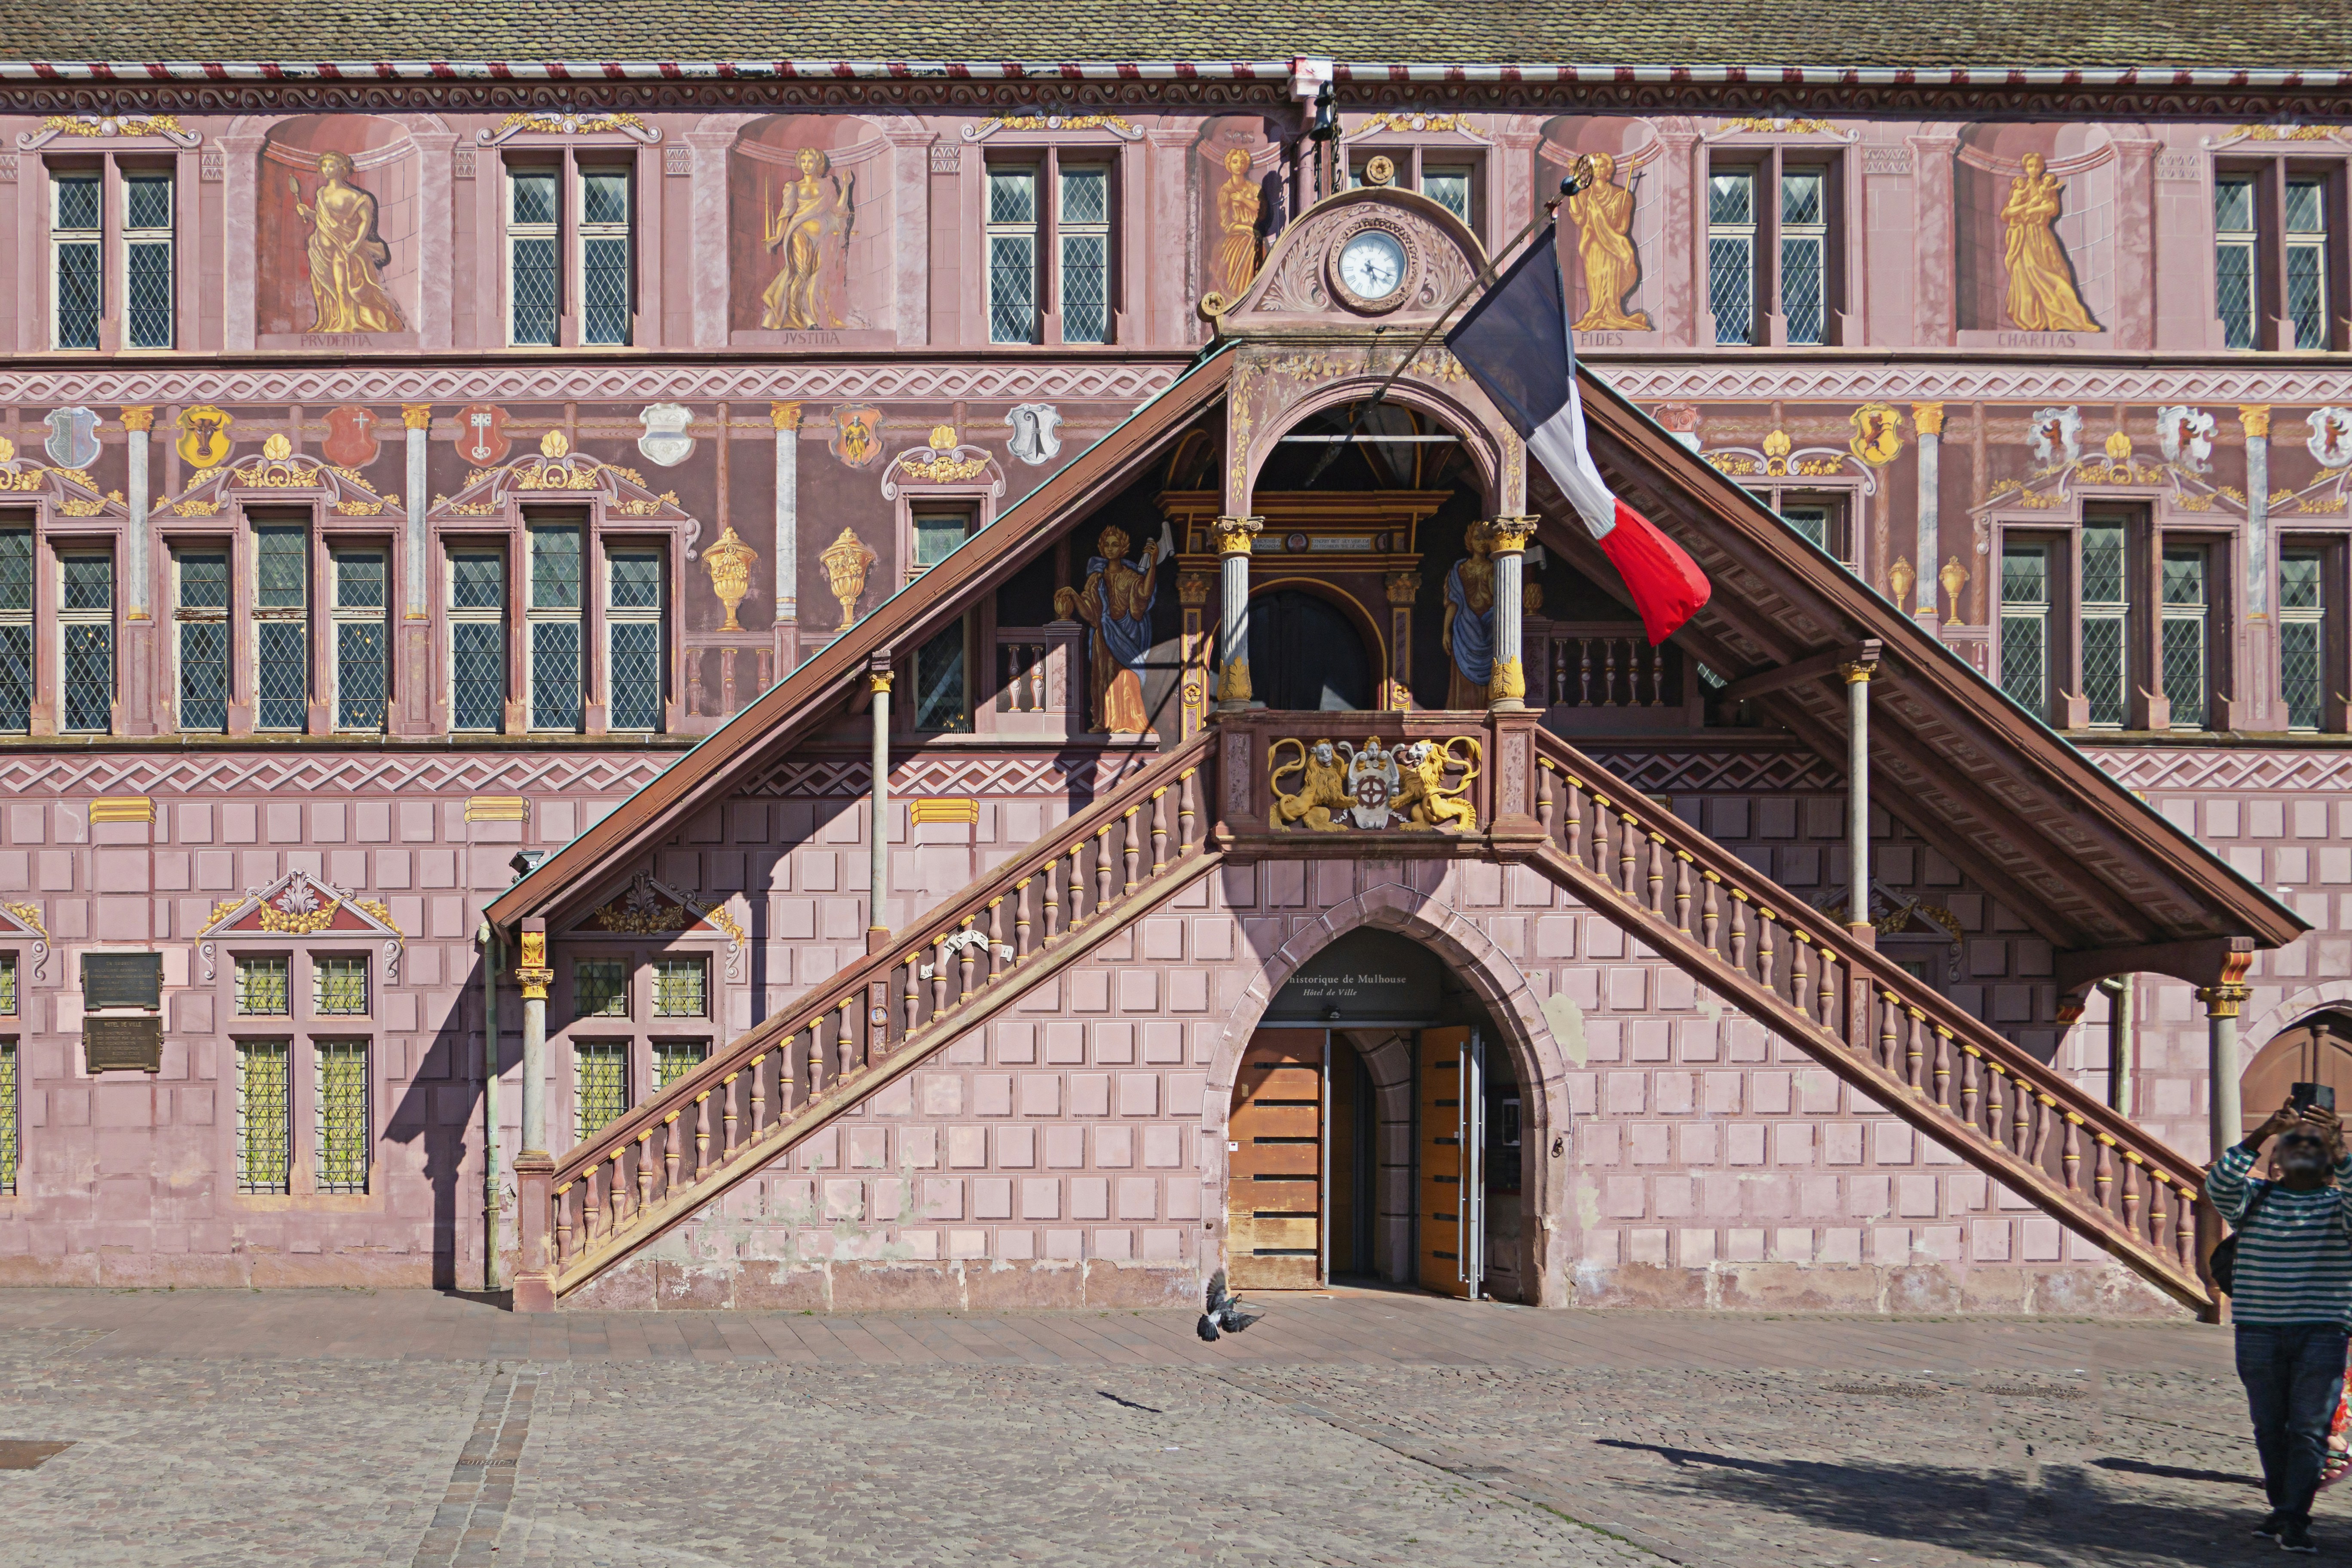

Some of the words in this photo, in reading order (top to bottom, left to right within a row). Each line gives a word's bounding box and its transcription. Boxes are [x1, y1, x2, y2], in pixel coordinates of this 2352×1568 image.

[1224, 129, 1255, 144] SPES
[301, 334, 373, 346] PRVDENTIA
[784, 331, 840, 344] JVSTITIA
[1581, 333, 1623, 346] FIDES
[1998, 333, 2076, 347] CHARITAS
[1289, 974, 1338, 986] historique
[1343, 974, 1354, 983] de
[1358, 974, 1406, 983] Mulhouse
